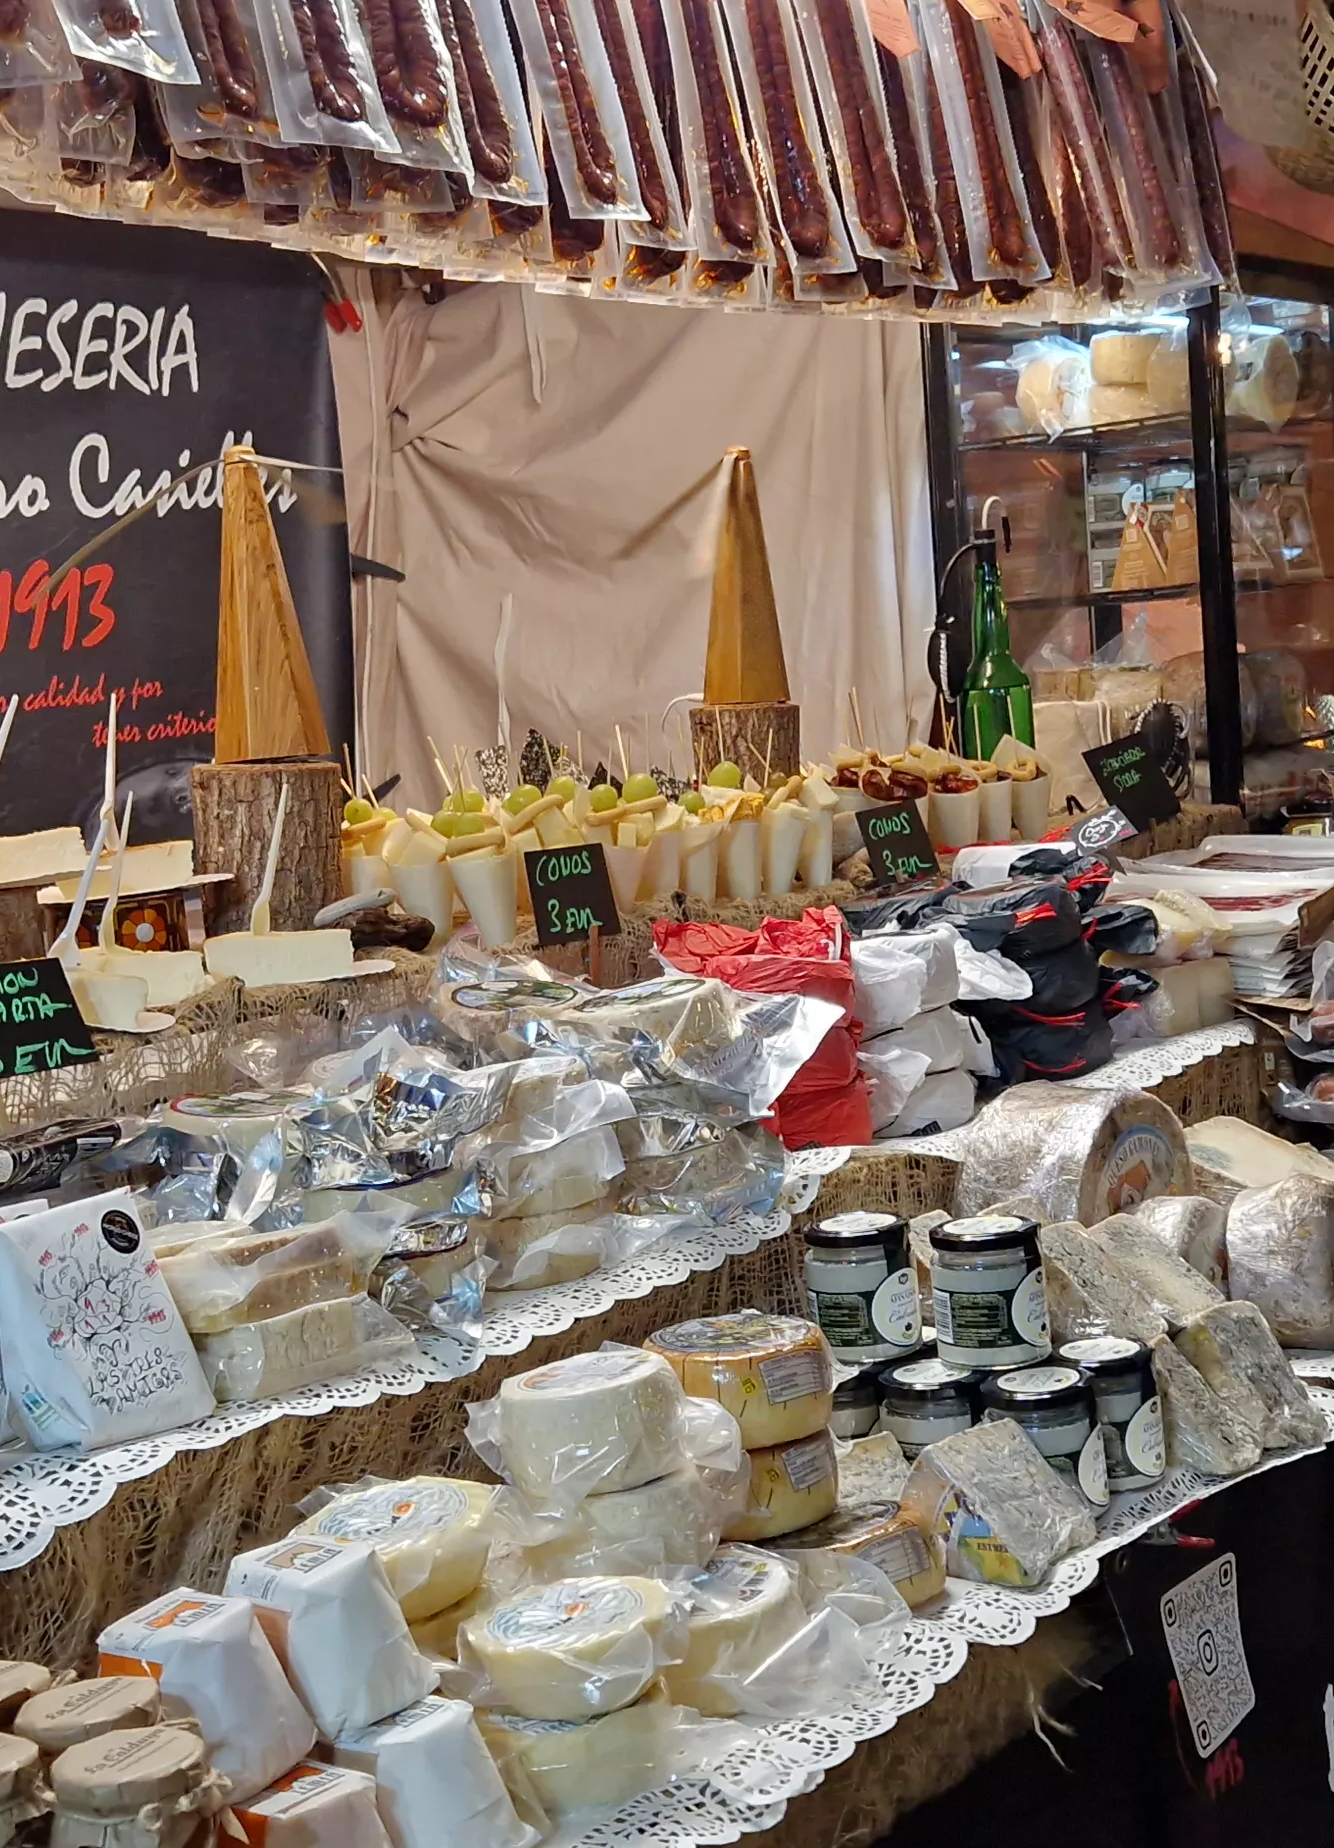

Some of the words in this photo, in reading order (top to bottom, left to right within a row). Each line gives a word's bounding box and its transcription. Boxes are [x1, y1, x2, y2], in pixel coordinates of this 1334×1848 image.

[22, 672, 106, 712] calidad
[123, 677, 164, 711] por
[882, 849, 895, 877] 3
[547, 898, 563, 934] 3
